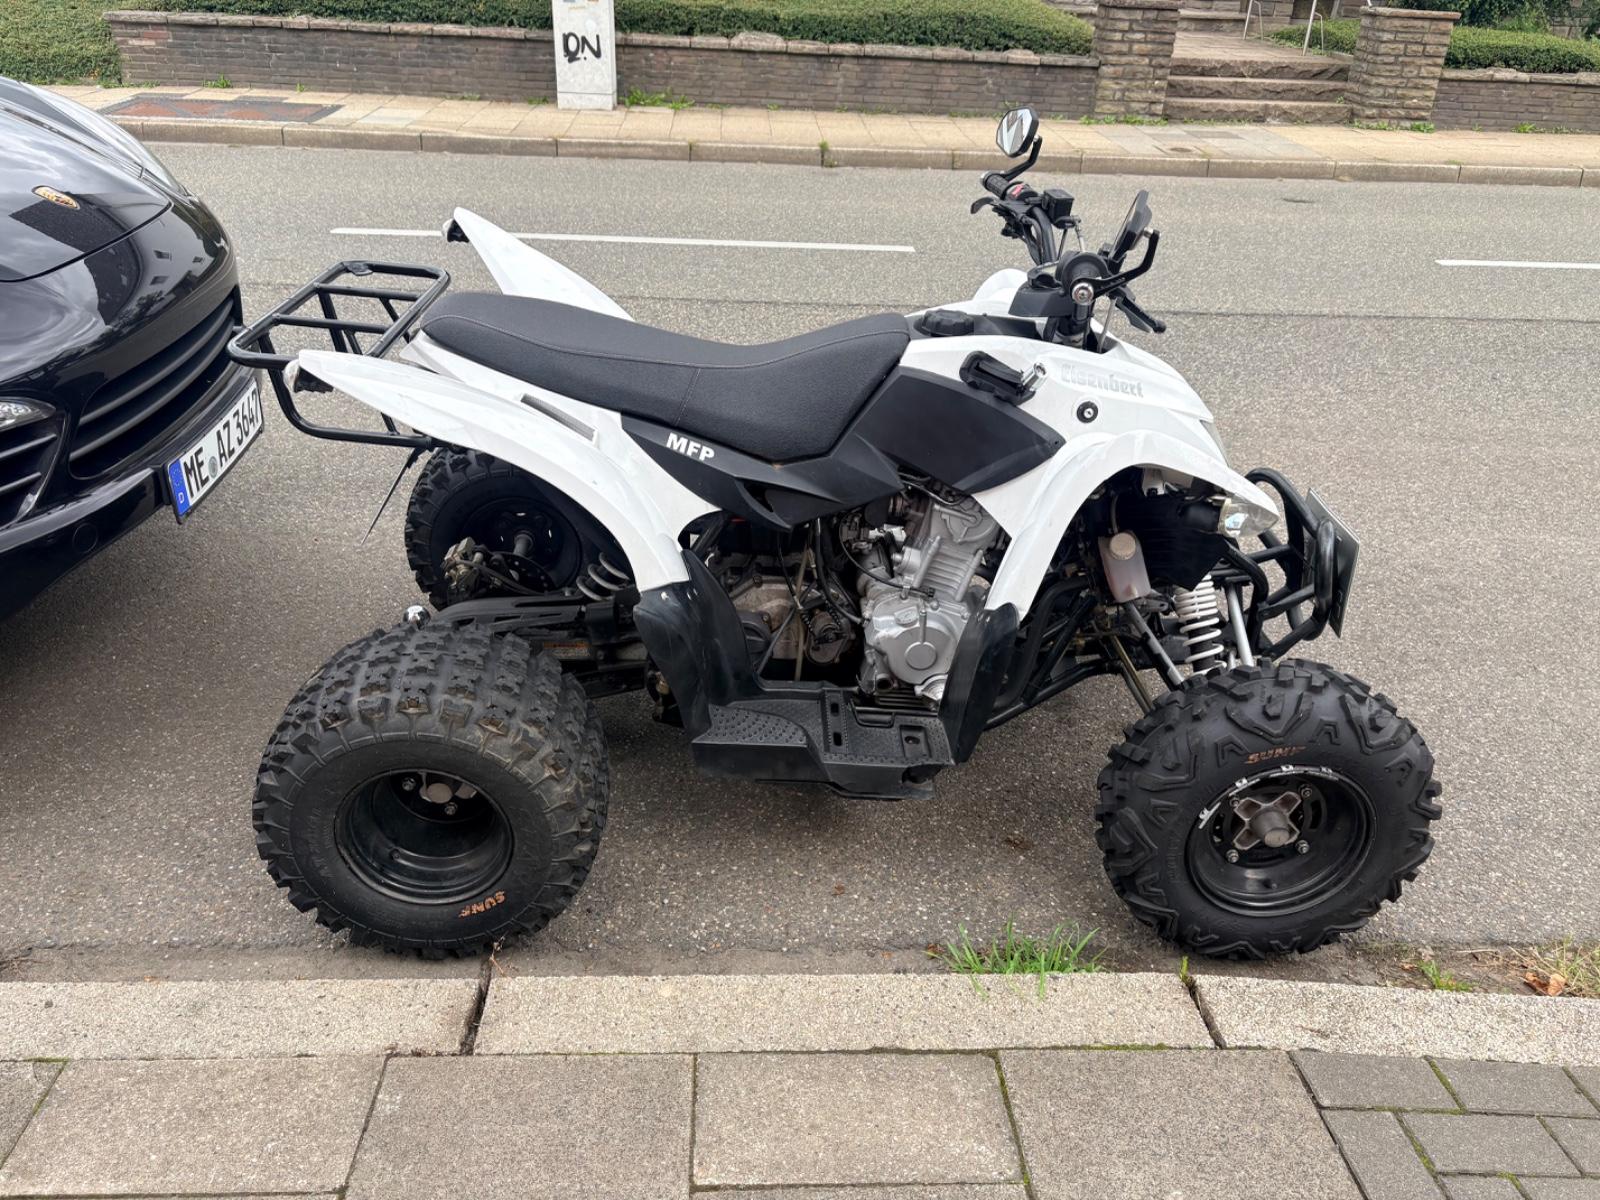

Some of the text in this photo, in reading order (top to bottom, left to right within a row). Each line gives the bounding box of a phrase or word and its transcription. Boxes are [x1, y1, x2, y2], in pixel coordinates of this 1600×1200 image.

[183, 387, 260, 499] ME AZ 3647
[666, 432, 715, 461] MFP
[178, 491, 185, 504] D
